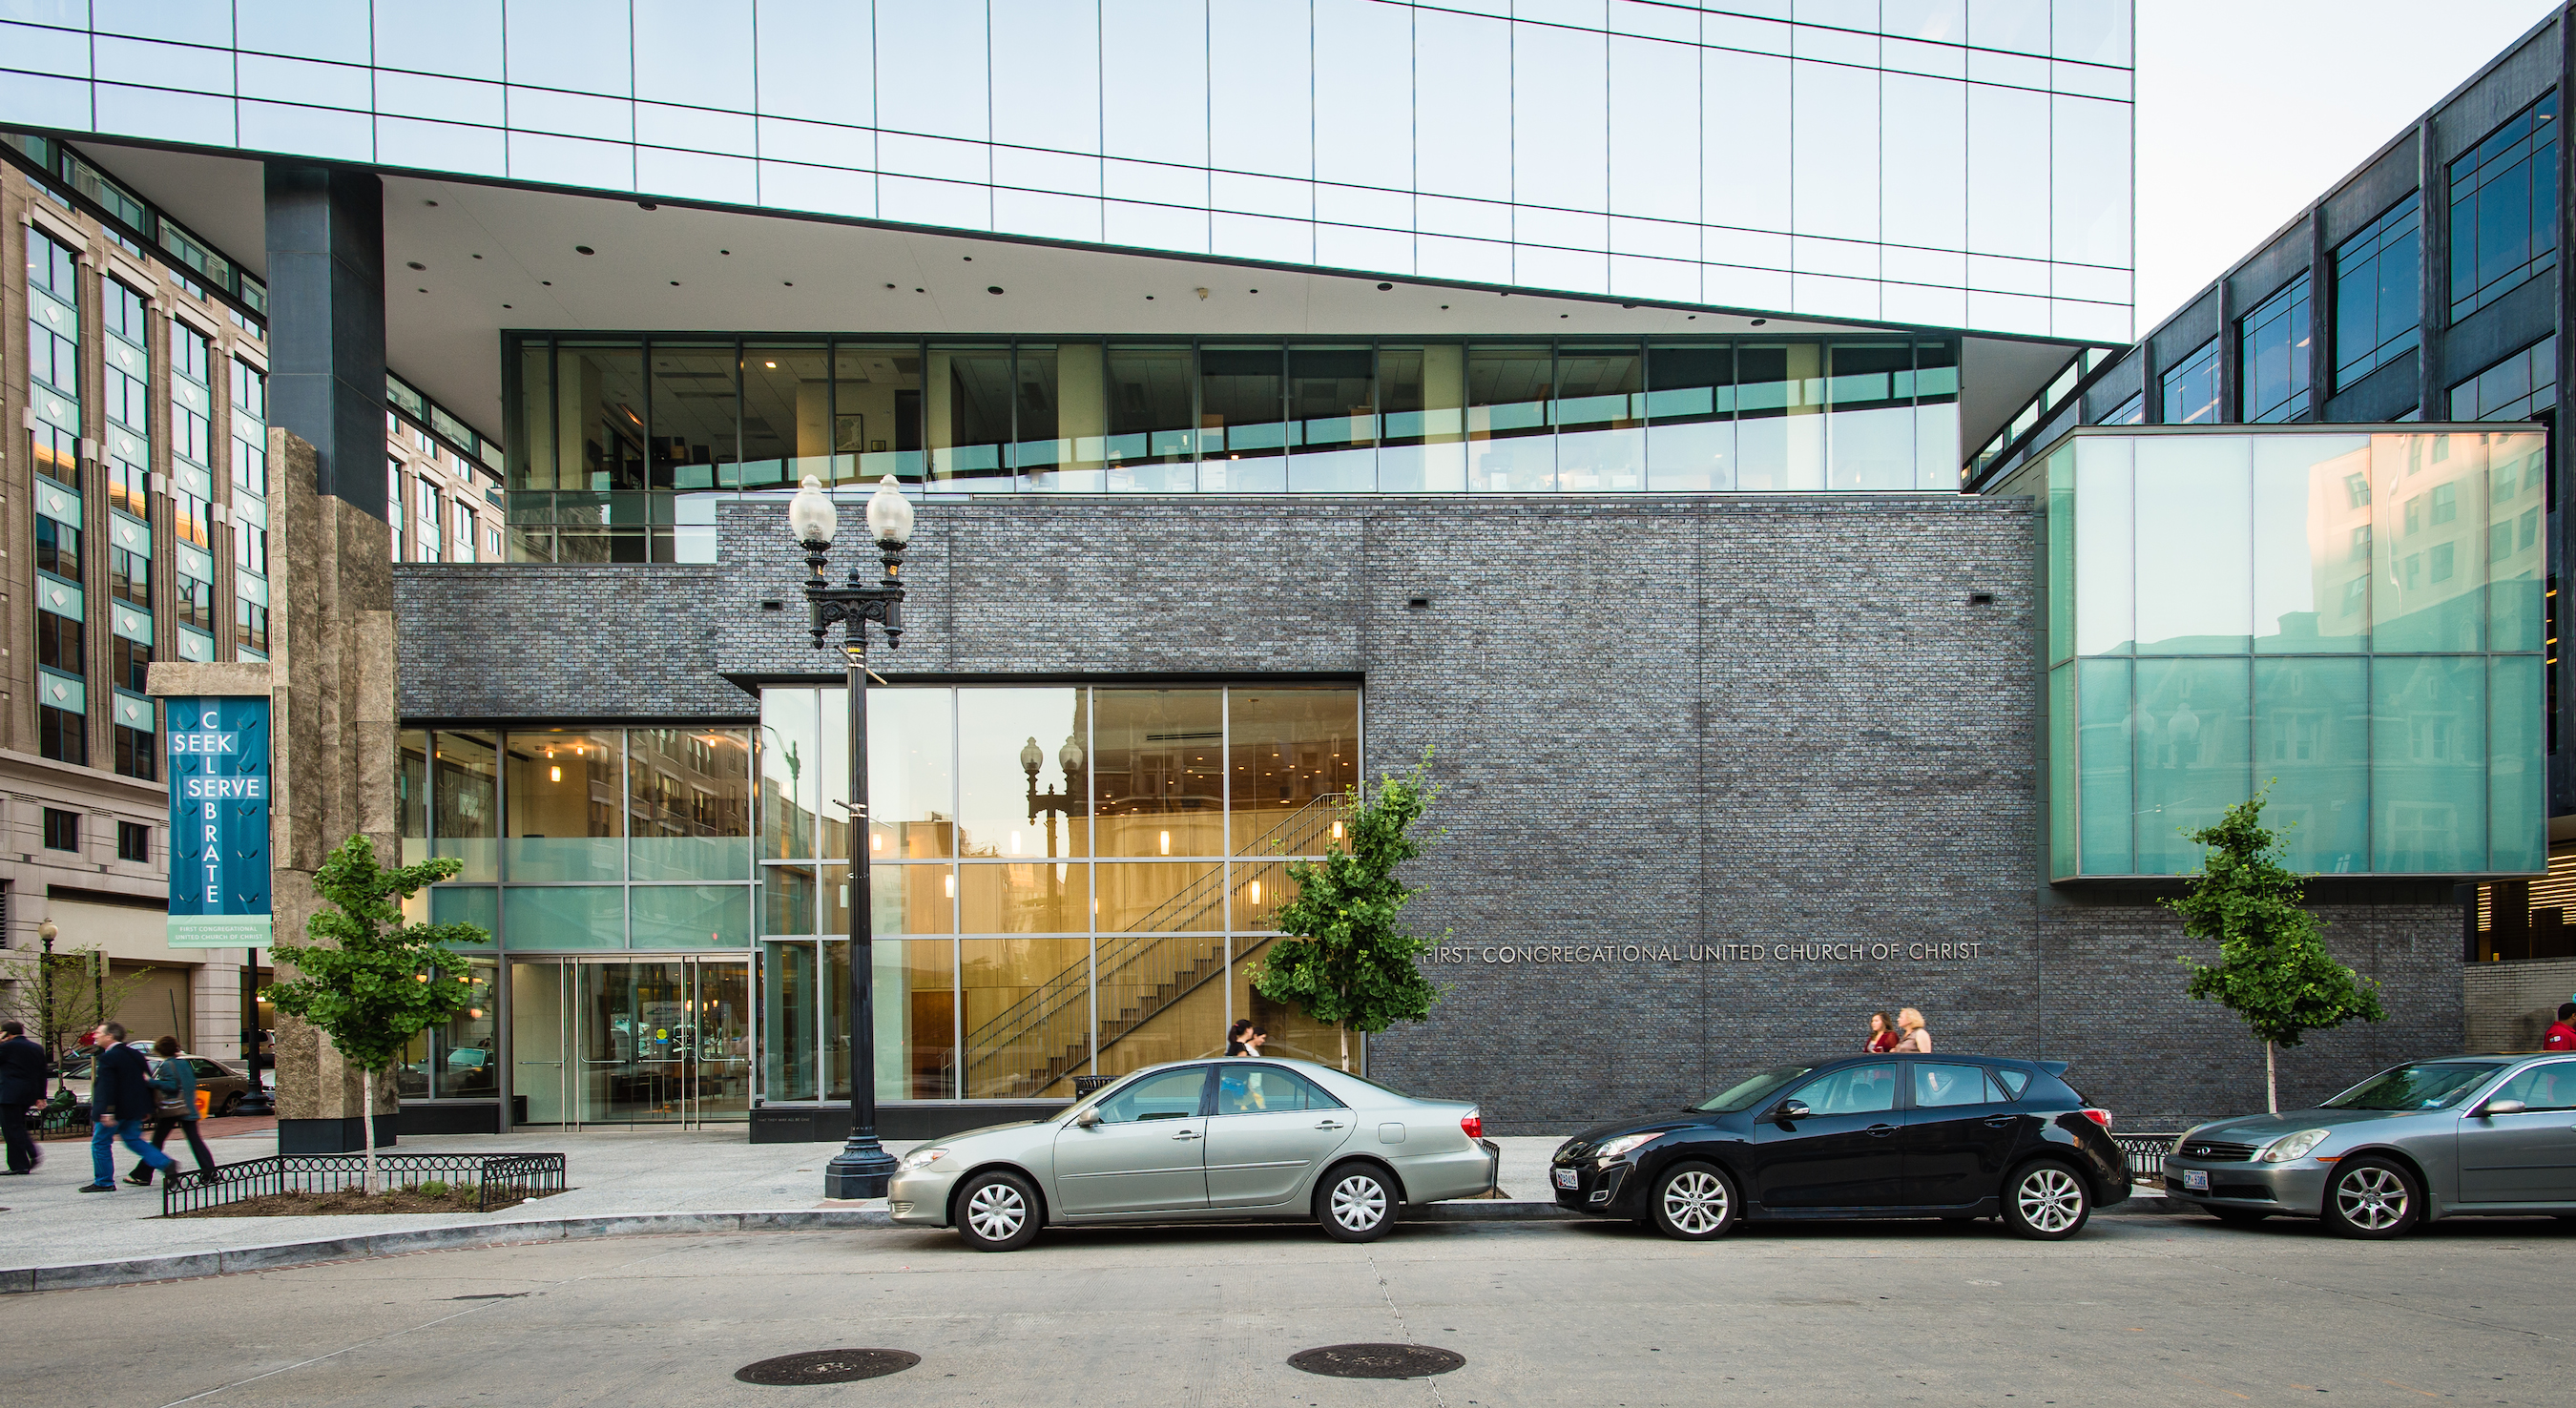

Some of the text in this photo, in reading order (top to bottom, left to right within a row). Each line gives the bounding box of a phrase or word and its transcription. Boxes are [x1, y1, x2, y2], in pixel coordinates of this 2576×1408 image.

[174, 734, 232, 753] SEEK
[187, 778, 260, 797] SERVE
[1423, 942, 1982, 963] FIRST CONGREGATIONAL UNITED CHURCH OF CHRIST
